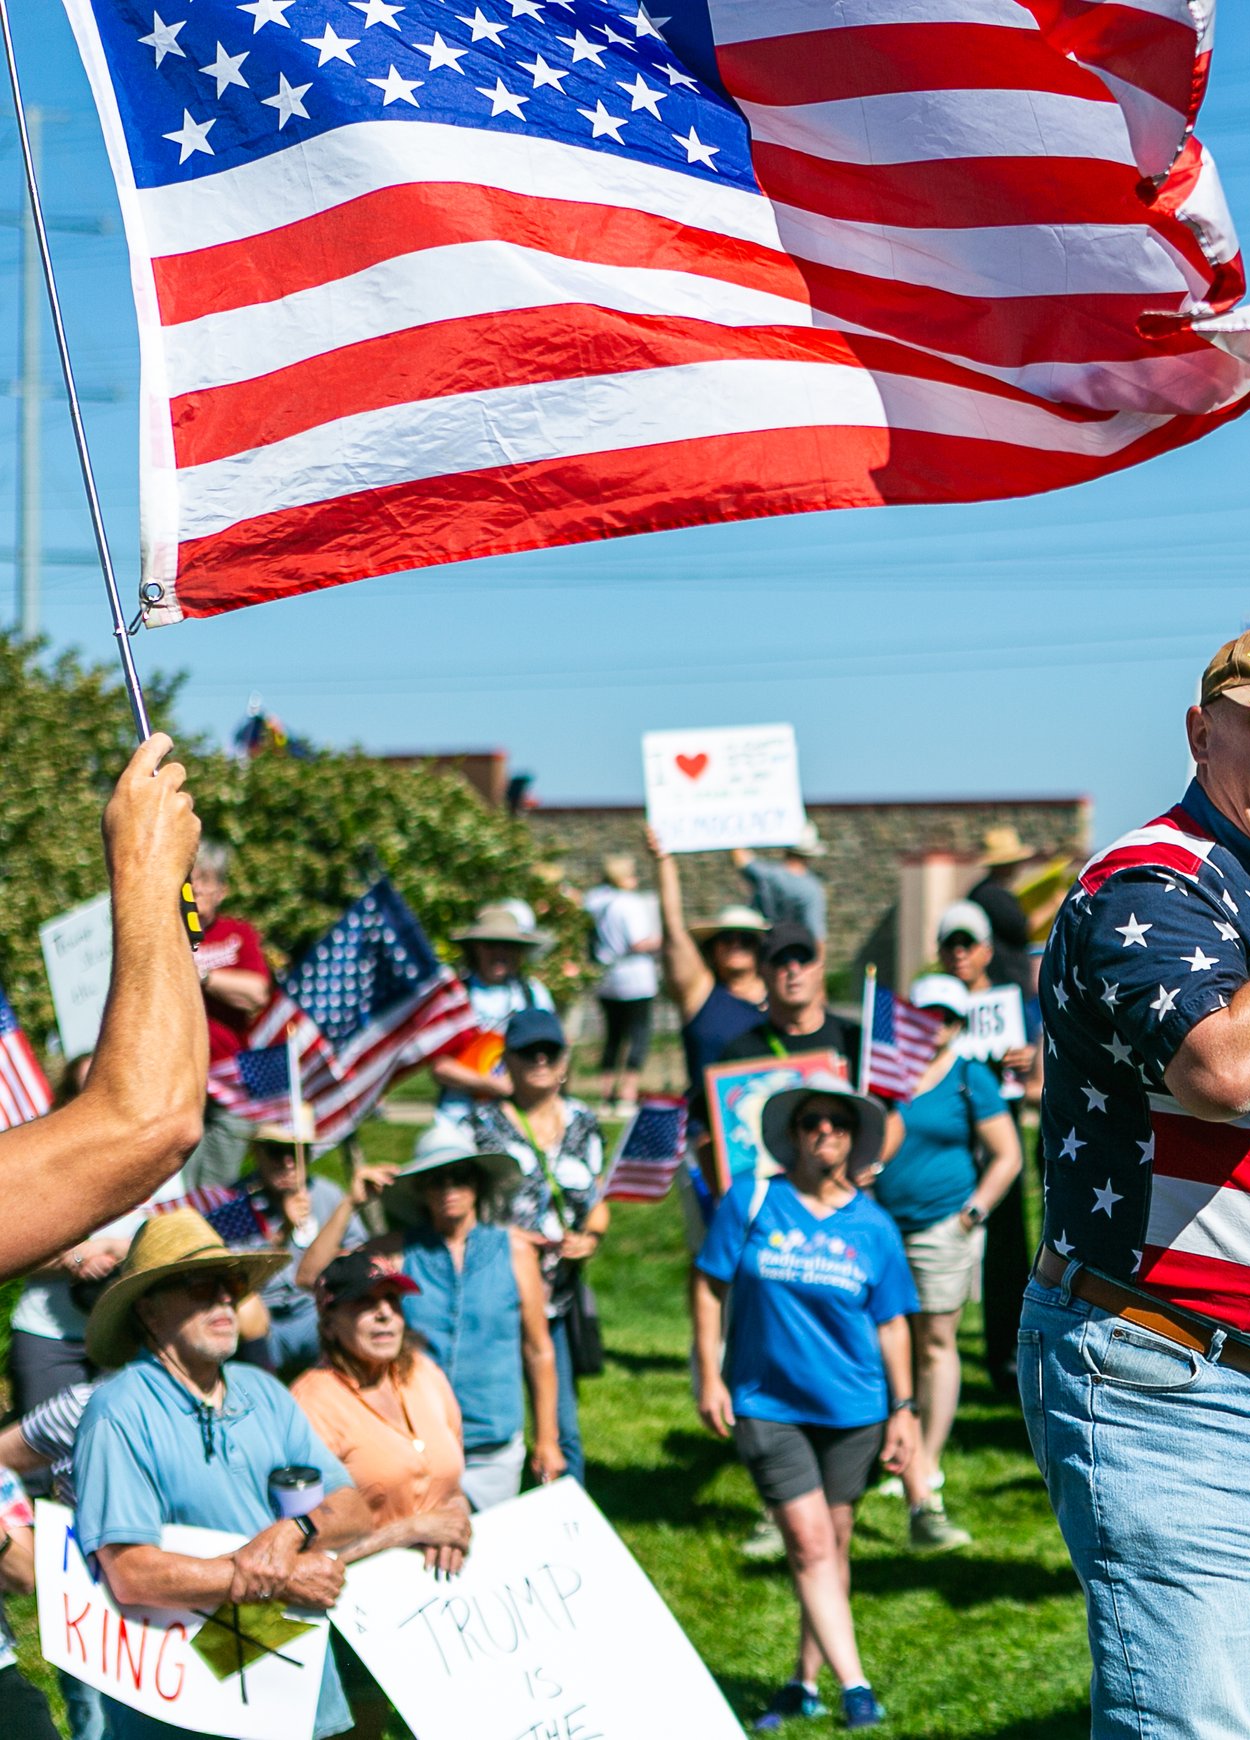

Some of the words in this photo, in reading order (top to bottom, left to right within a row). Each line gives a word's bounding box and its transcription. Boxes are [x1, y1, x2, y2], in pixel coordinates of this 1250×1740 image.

[63, 1591, 188, 1702] KING
[398, 1563, 582, 1677] TRUMP
[524, 1667, 563, 1699] IS
